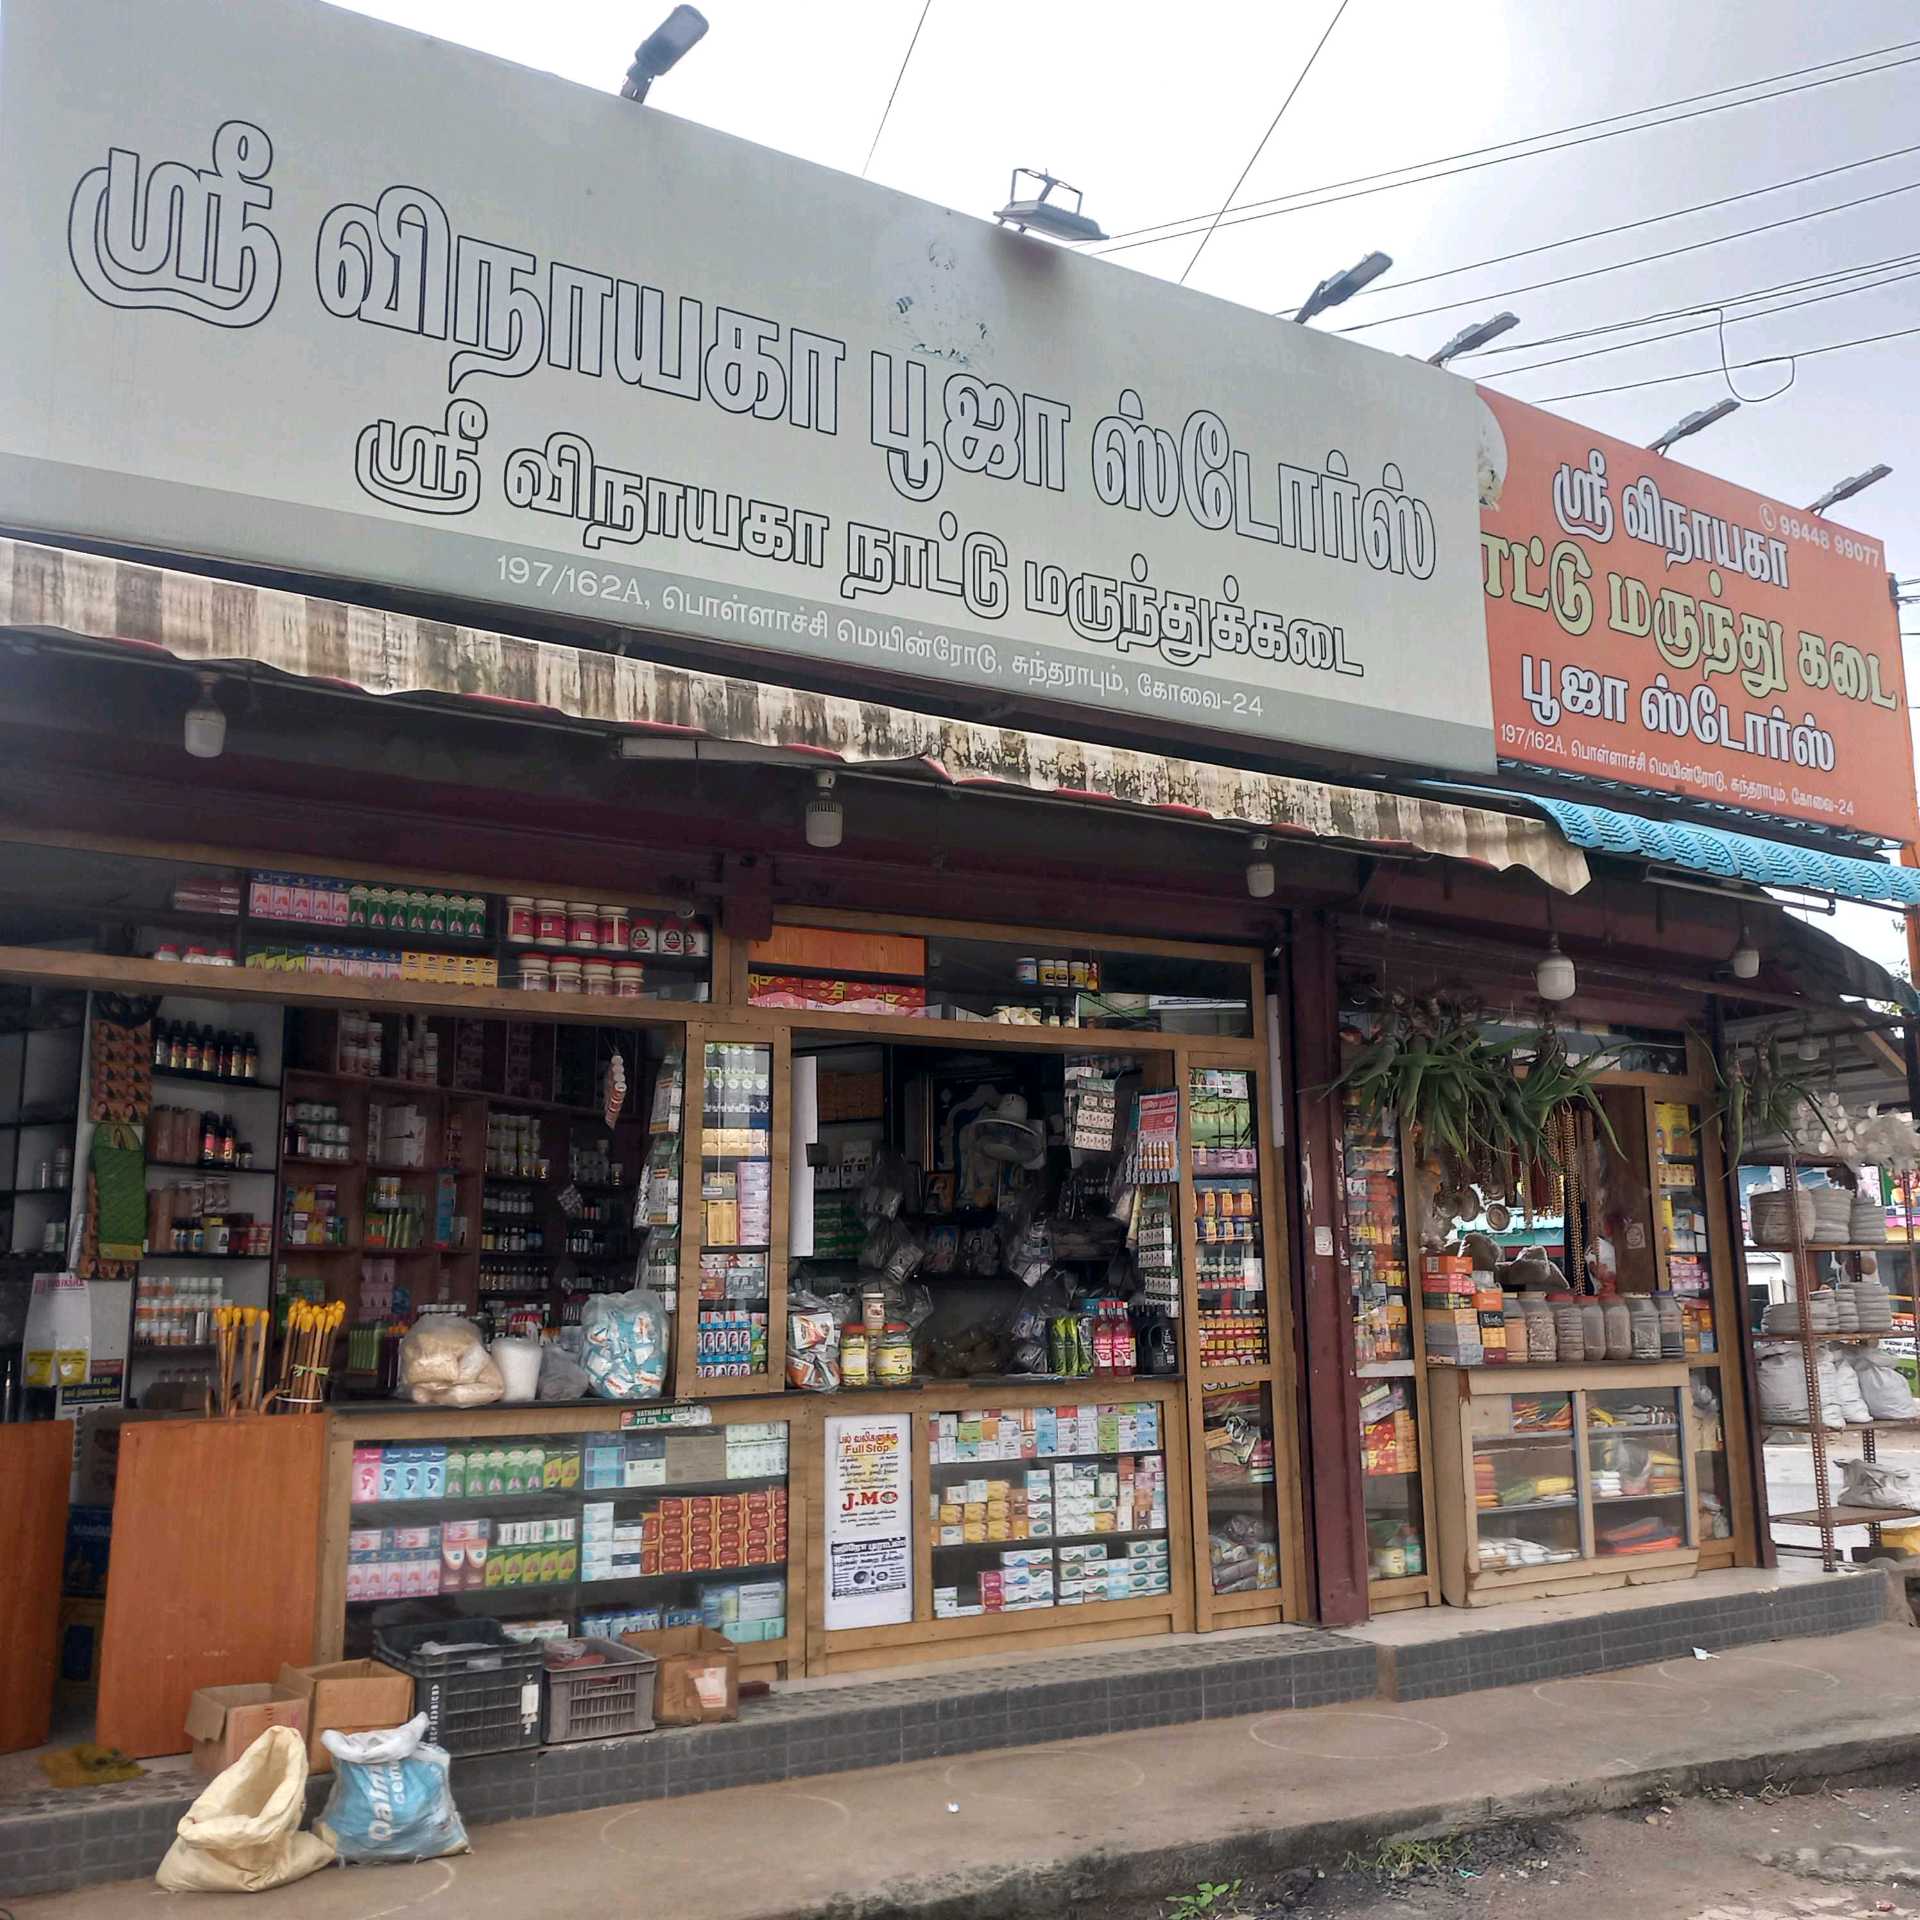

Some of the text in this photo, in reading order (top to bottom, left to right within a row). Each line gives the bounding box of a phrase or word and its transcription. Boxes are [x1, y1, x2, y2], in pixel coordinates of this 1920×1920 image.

[68, 119, 1436, 580] ஸ்ரீ விநாயகா பூஜா ஸ்டோர்ஸ்
[355, 398, 1365, 678] ஸ்ரீ விநாயகா நாட்டு மருந்துக்கடை
[1553, 449, 1790, 589] ஸ்ரீ விநாயகா
[1780, 515, 1880, 568] 99448 99077
[497, 555, 651, 610] 197/162A,
[662, 585, 829, 639] பொள்ளாச்சி
[837, 618, 1003, 676] மெயின்ரோடு,
[1137, 672, 1265, 718] கோவை-24
[1607, 570, 1789, 700] மருந்து
[1797, 631, 1898, 711] கடை
[1521, 653, 1837, 772] பூஜா ஸ்டோர்ஸ்
[846, 1444, 889, 1454] Full Stop
